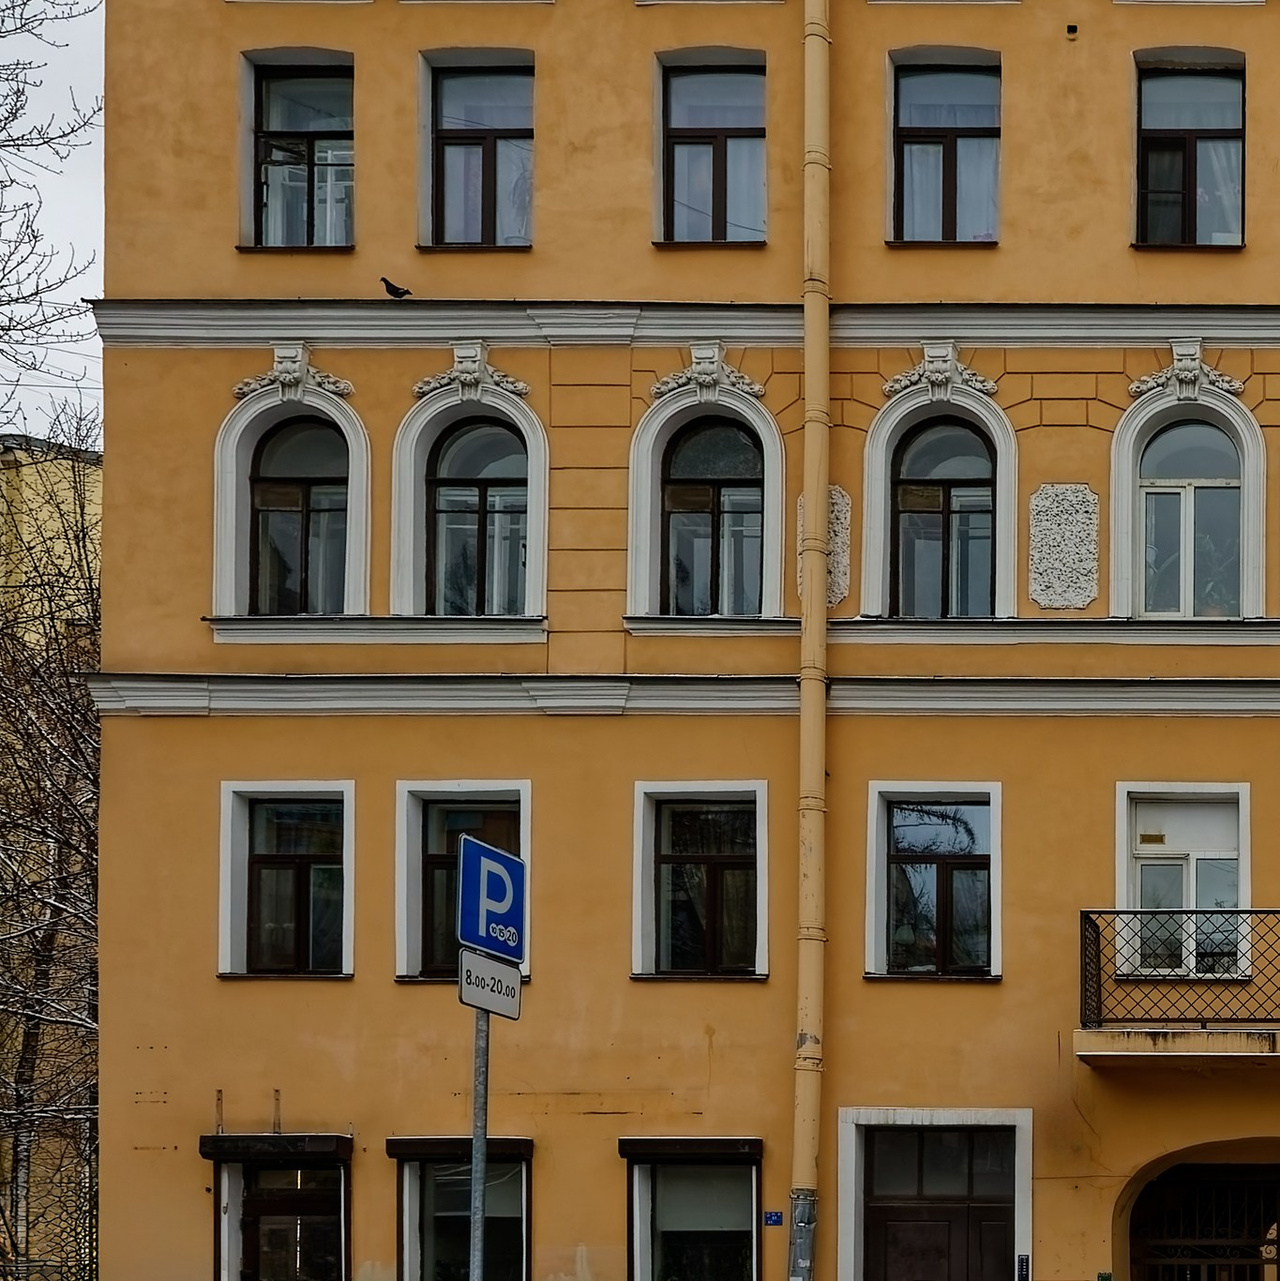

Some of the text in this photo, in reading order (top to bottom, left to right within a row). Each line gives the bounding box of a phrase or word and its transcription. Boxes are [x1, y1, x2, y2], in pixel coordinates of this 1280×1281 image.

[479, 856, 514, 937] P
[507, 929, 516, 943] 20
[465, 969, 516, 999] 8.00-20.00
